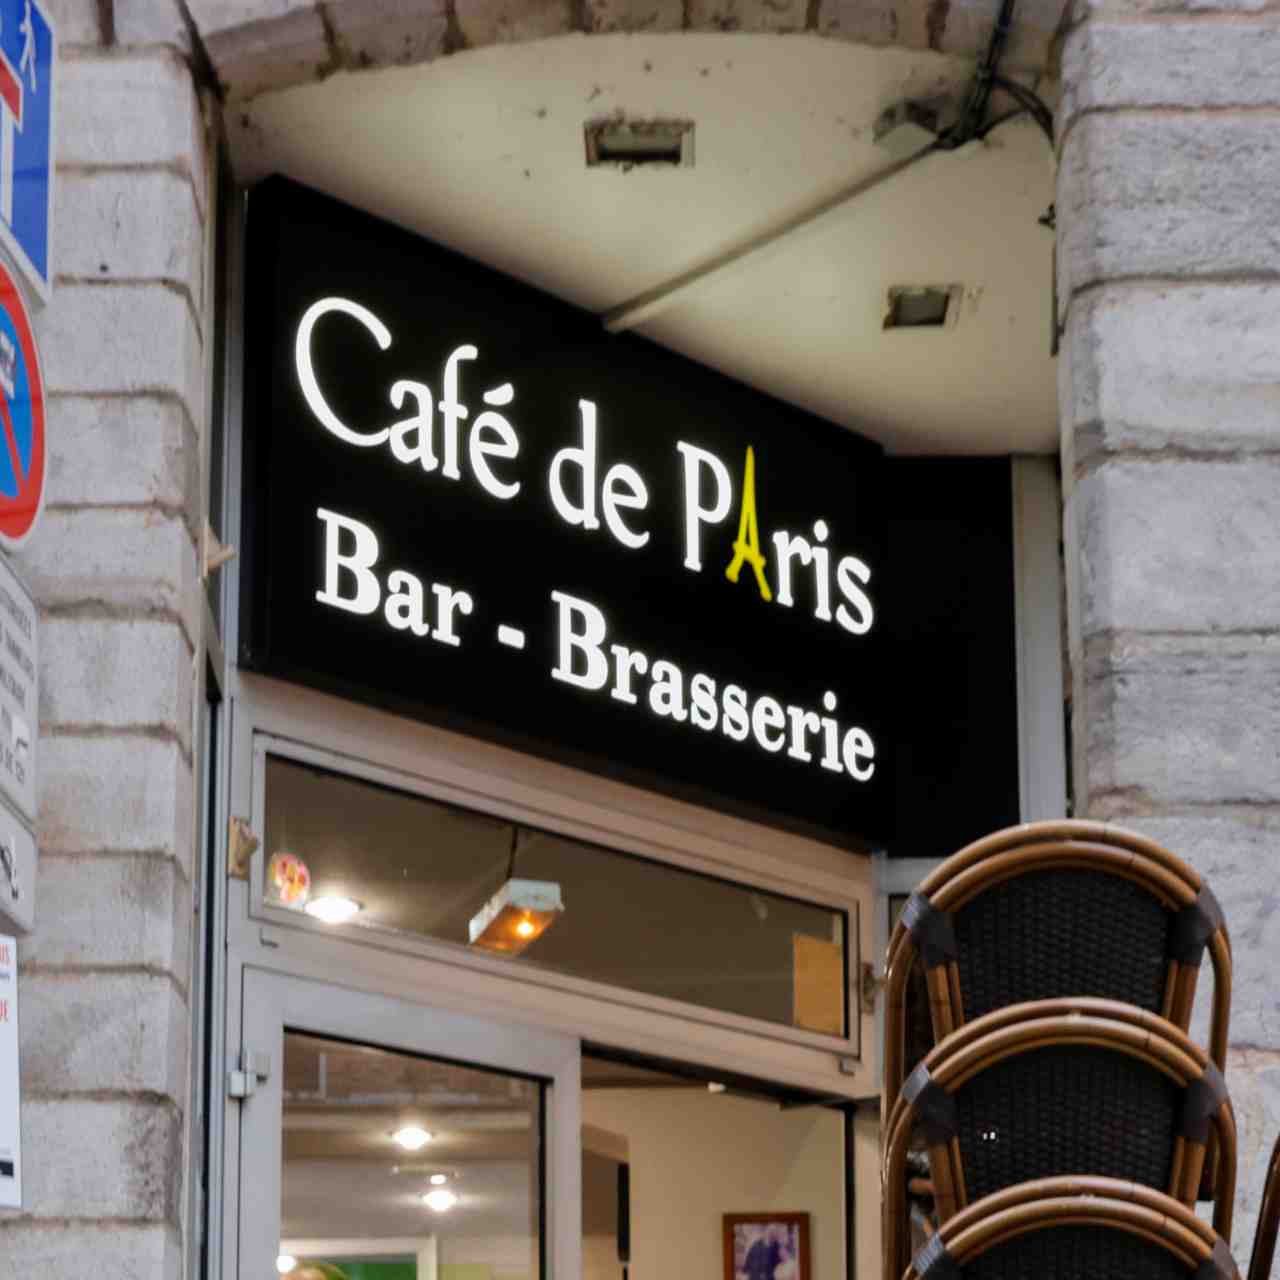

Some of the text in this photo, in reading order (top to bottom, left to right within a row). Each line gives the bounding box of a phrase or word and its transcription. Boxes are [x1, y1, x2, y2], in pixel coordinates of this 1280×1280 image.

[295, 297, 521, 500] Café
[549, 399, 650, 548] de
[316, 507, 473, 647] Bar
[551, 590, 876, 782] Brasserie
